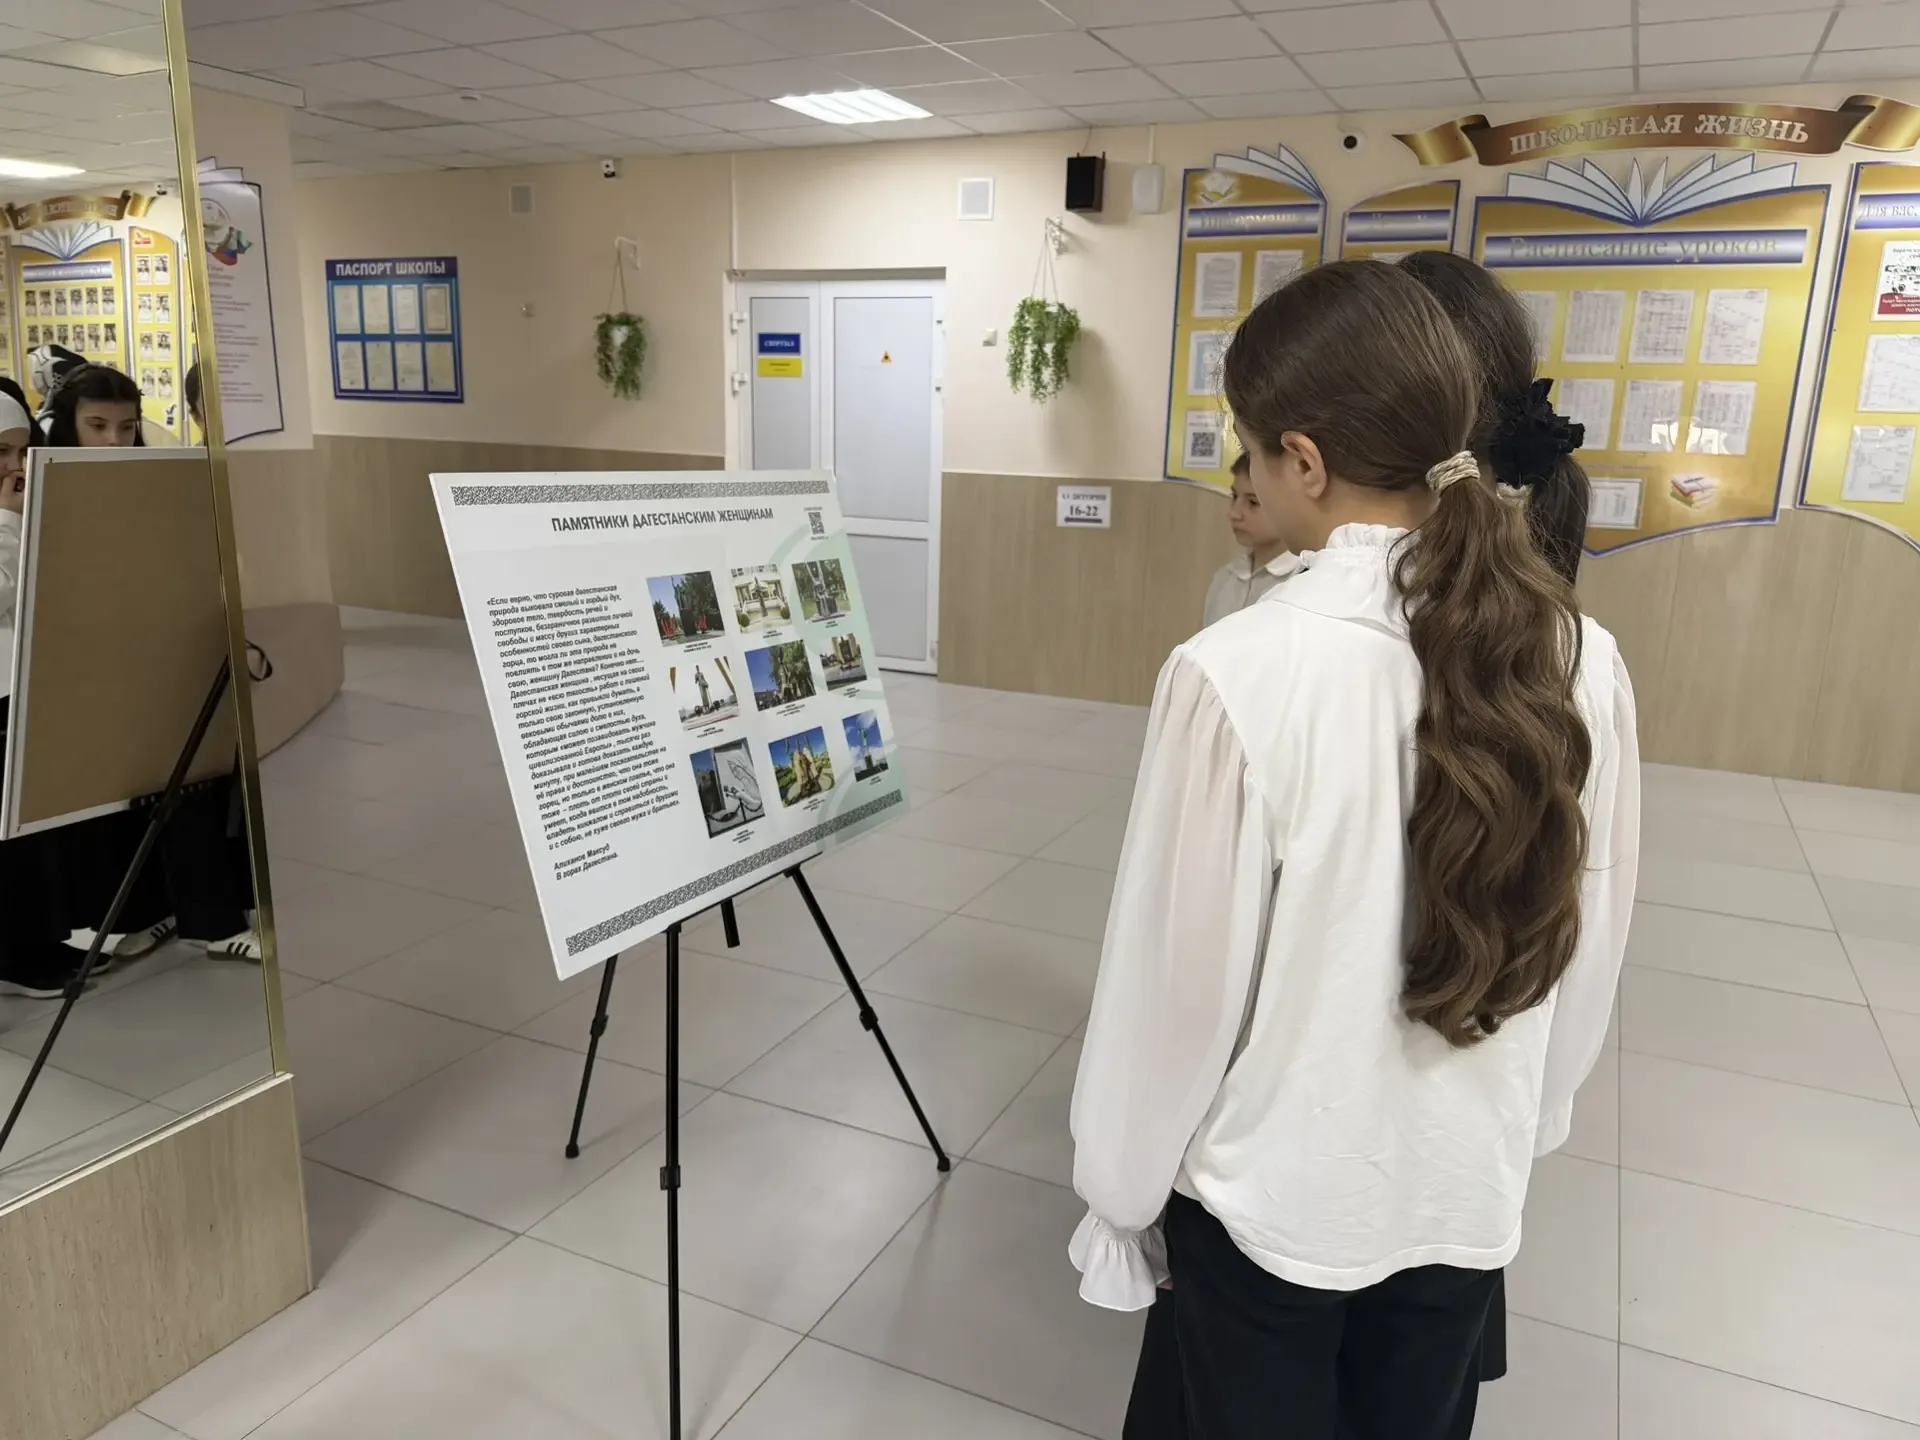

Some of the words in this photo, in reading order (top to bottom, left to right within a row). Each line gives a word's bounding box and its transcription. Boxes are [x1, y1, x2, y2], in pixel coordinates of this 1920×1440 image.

[1509, 114, 1685, 155] ШКОЛЬНАЯ
[1694, 114, 1809, 145] ЖИЗНЬ
[1508, 237, 1668, 260] Расписание
[1676, 236, 1778, 263] уроков
[335, 262, 393, 277] ПАСПОРТ
[395, 260, 446, 275] ШКОЛЫ
[552, 514, 630, 532] ПАМЯТНИКИ
[632, 509, 717, 529] ДАГЕСТАНСКИМ
[717, 507, 774, 523] ЖЕНЩИНАМ
[1069, 504, 1099, 517] 16-22
